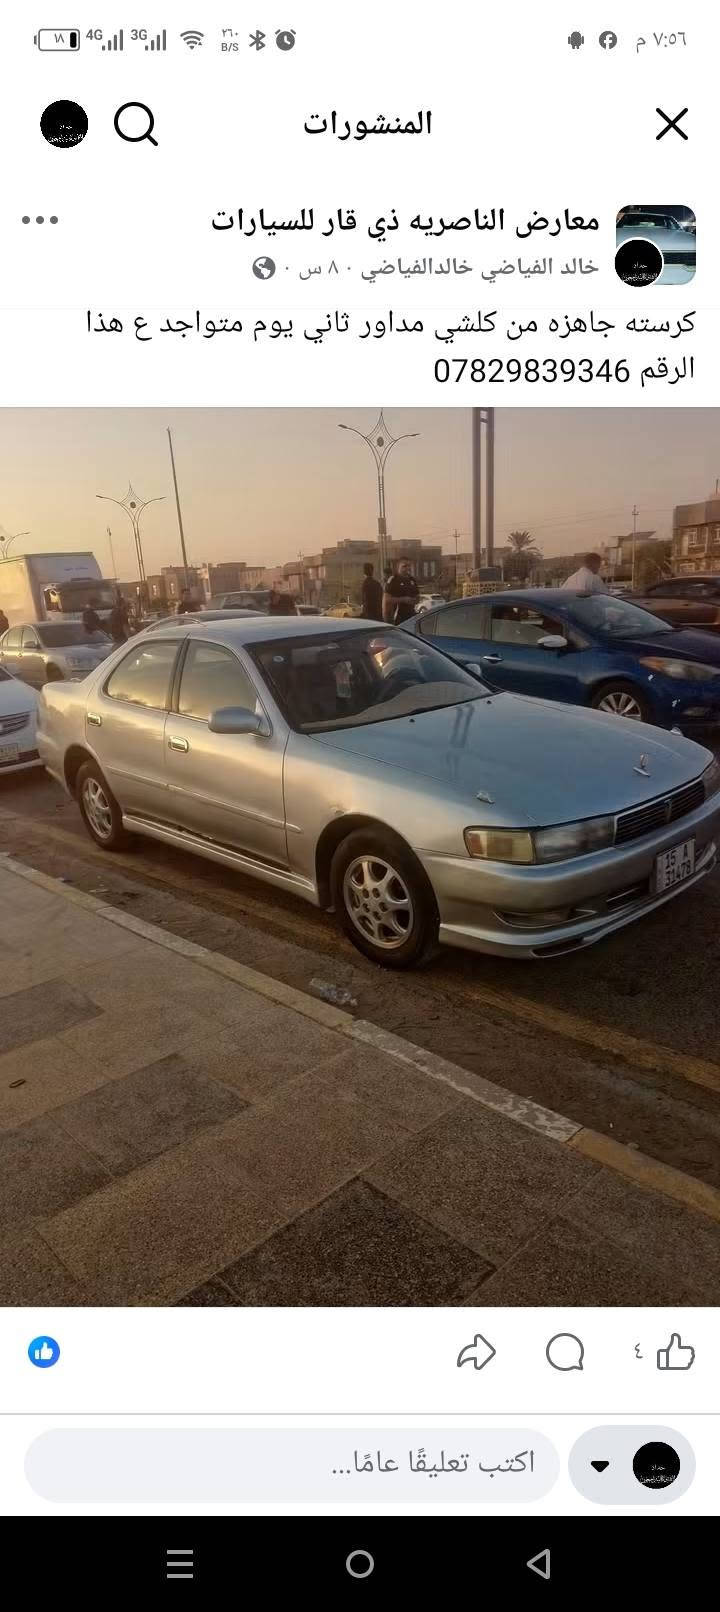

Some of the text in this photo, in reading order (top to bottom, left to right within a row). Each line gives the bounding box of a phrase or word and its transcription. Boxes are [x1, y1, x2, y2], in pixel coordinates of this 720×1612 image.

[85, 29, 103, 41] 4G
[130, 29, 148, 41] 3G
[221, 29, 239, 38] ٢٦٠
[635, 31, 687, 54] ٧:٥٦ م
[221, 43, 239, 52] B/S
[303, 110, 433, 142] المنشورات
[211, 207, 600, 244] معارض الناصريه ذي قار للسيارات
[298, 257, 600, 284] خالد الفياضي خالدالفياضي ٨ س
[86, 309, 697, 345] كرسته جاهزه من كلشي مداور ثاني يوم متواجد ع هذا
[433, 355, 695, 389] الرقم 07829839346
[665, 850, 677, 869] 15
[634, 1342, 644, 1360] ٤
[408, 1447, 470, 1479] تعليقًا
[478, 1449, 535, 1479] اكتب
